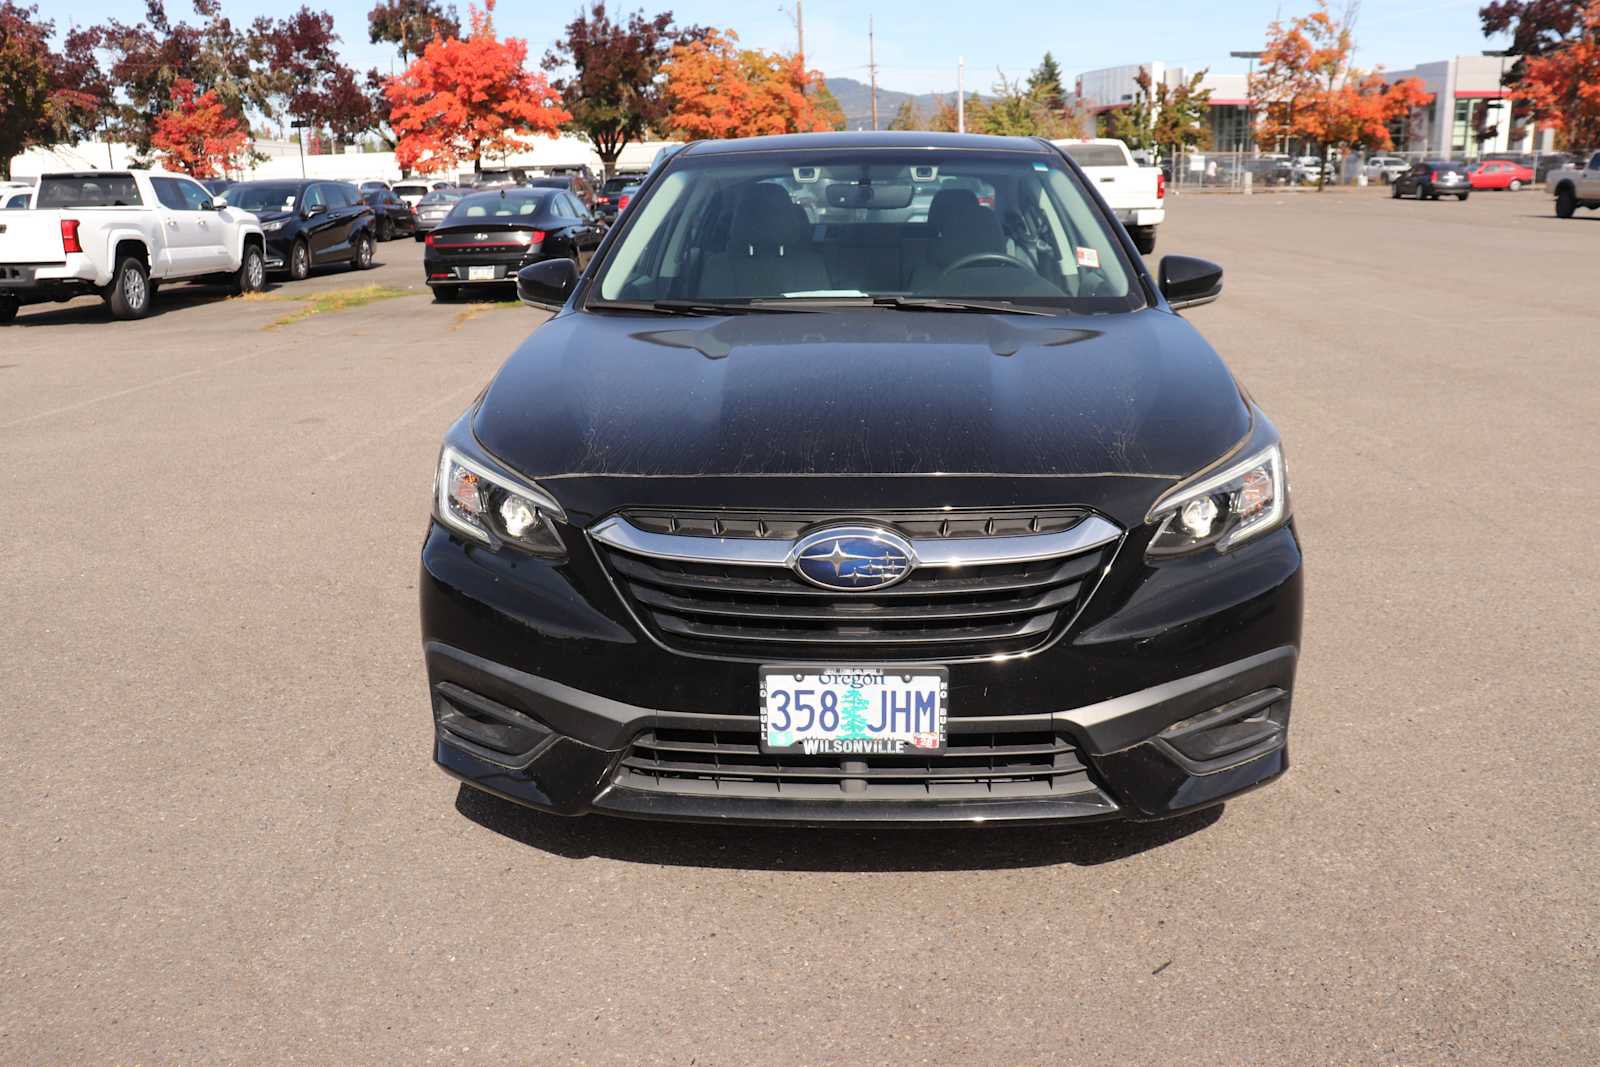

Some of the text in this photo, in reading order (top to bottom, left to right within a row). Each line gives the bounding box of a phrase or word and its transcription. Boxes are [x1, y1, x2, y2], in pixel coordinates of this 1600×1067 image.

[819, 673, 885, 688] Oregon
[770, 690, 936, 733] 358 JHM
[803, 738, 905, 755] WILSONVILLE
